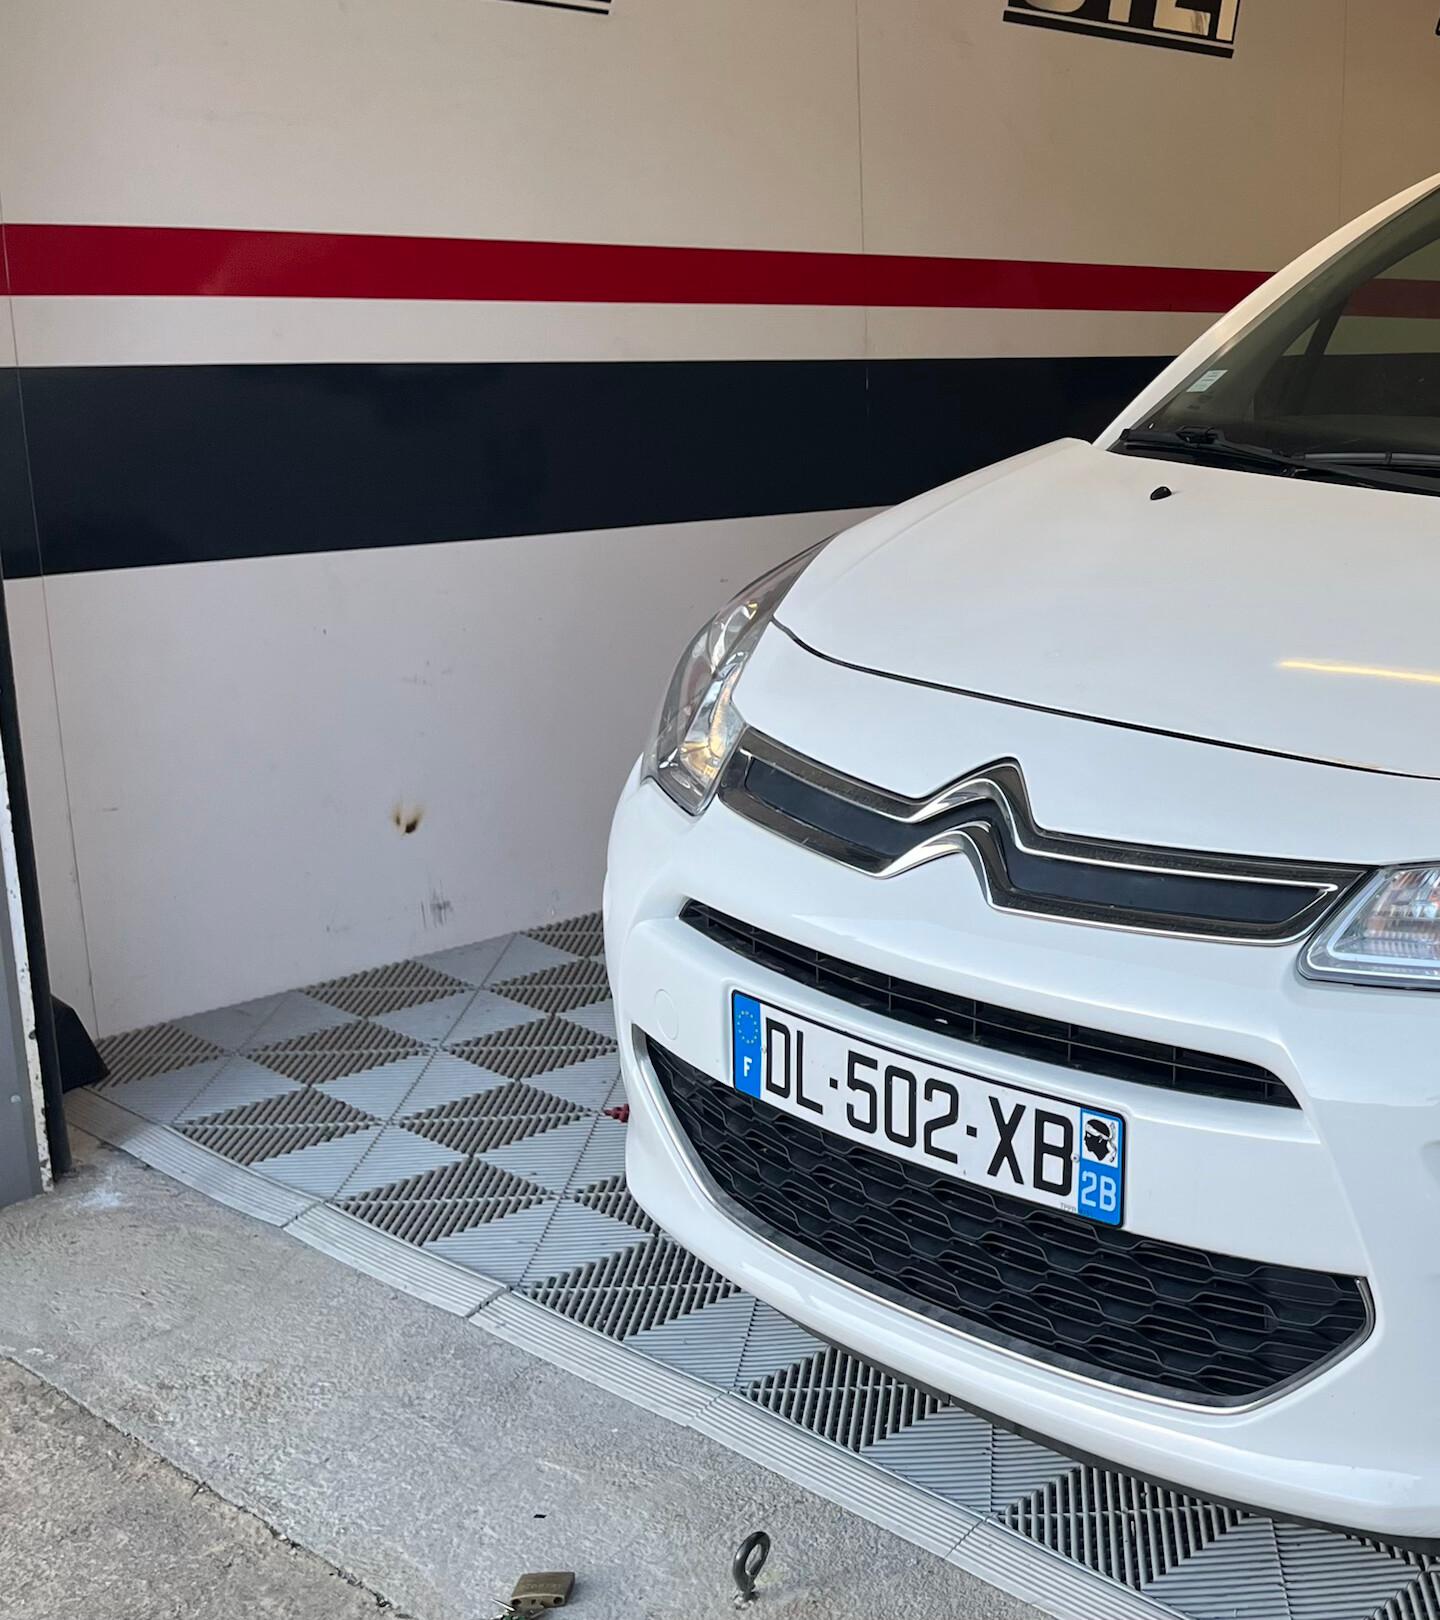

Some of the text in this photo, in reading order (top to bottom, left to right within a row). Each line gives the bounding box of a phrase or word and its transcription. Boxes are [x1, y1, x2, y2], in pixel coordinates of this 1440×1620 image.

[743, 1057, 753, 1078] F
[765, 1017, 1074, 1197] DL-502-XB
[1081, 1170, 1118, 1213] 2B
